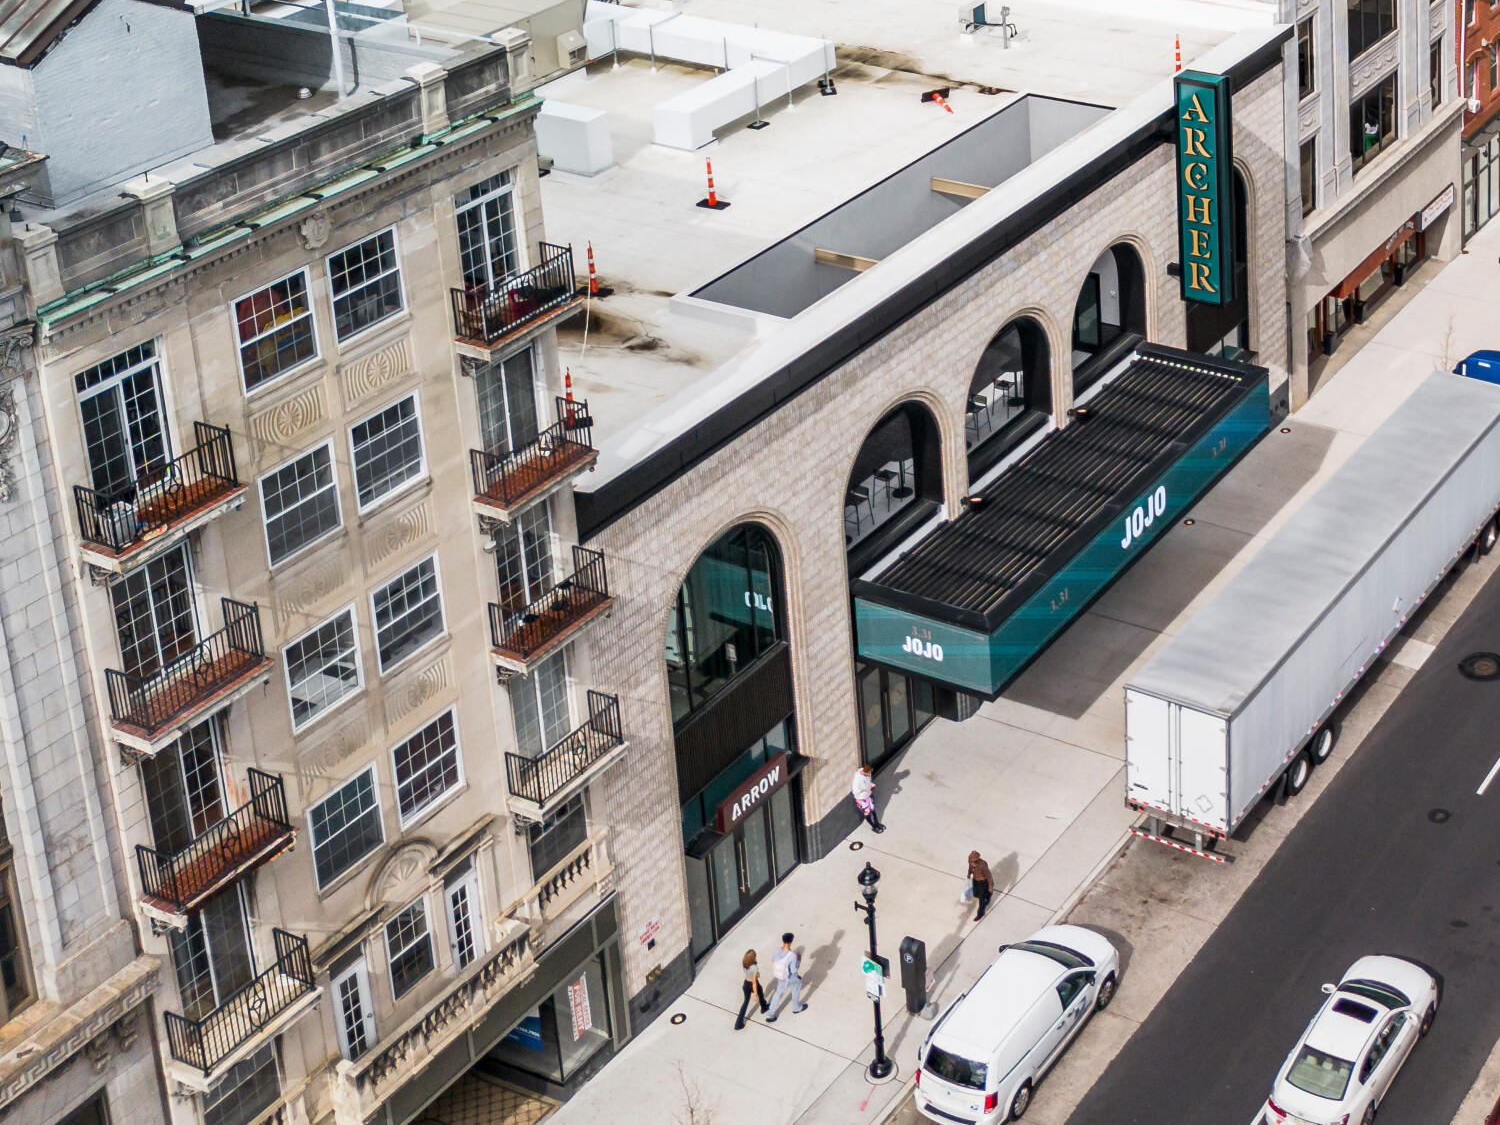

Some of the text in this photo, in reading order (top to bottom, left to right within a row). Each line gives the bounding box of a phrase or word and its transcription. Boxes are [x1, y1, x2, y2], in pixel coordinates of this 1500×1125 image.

[1182, 93, 1217, 293] ARCHER
[1121, 485, 1166, 549] JOJO
[902, 635, 944, 663] JOJO
[731, 765, 780, 822] ARROW
